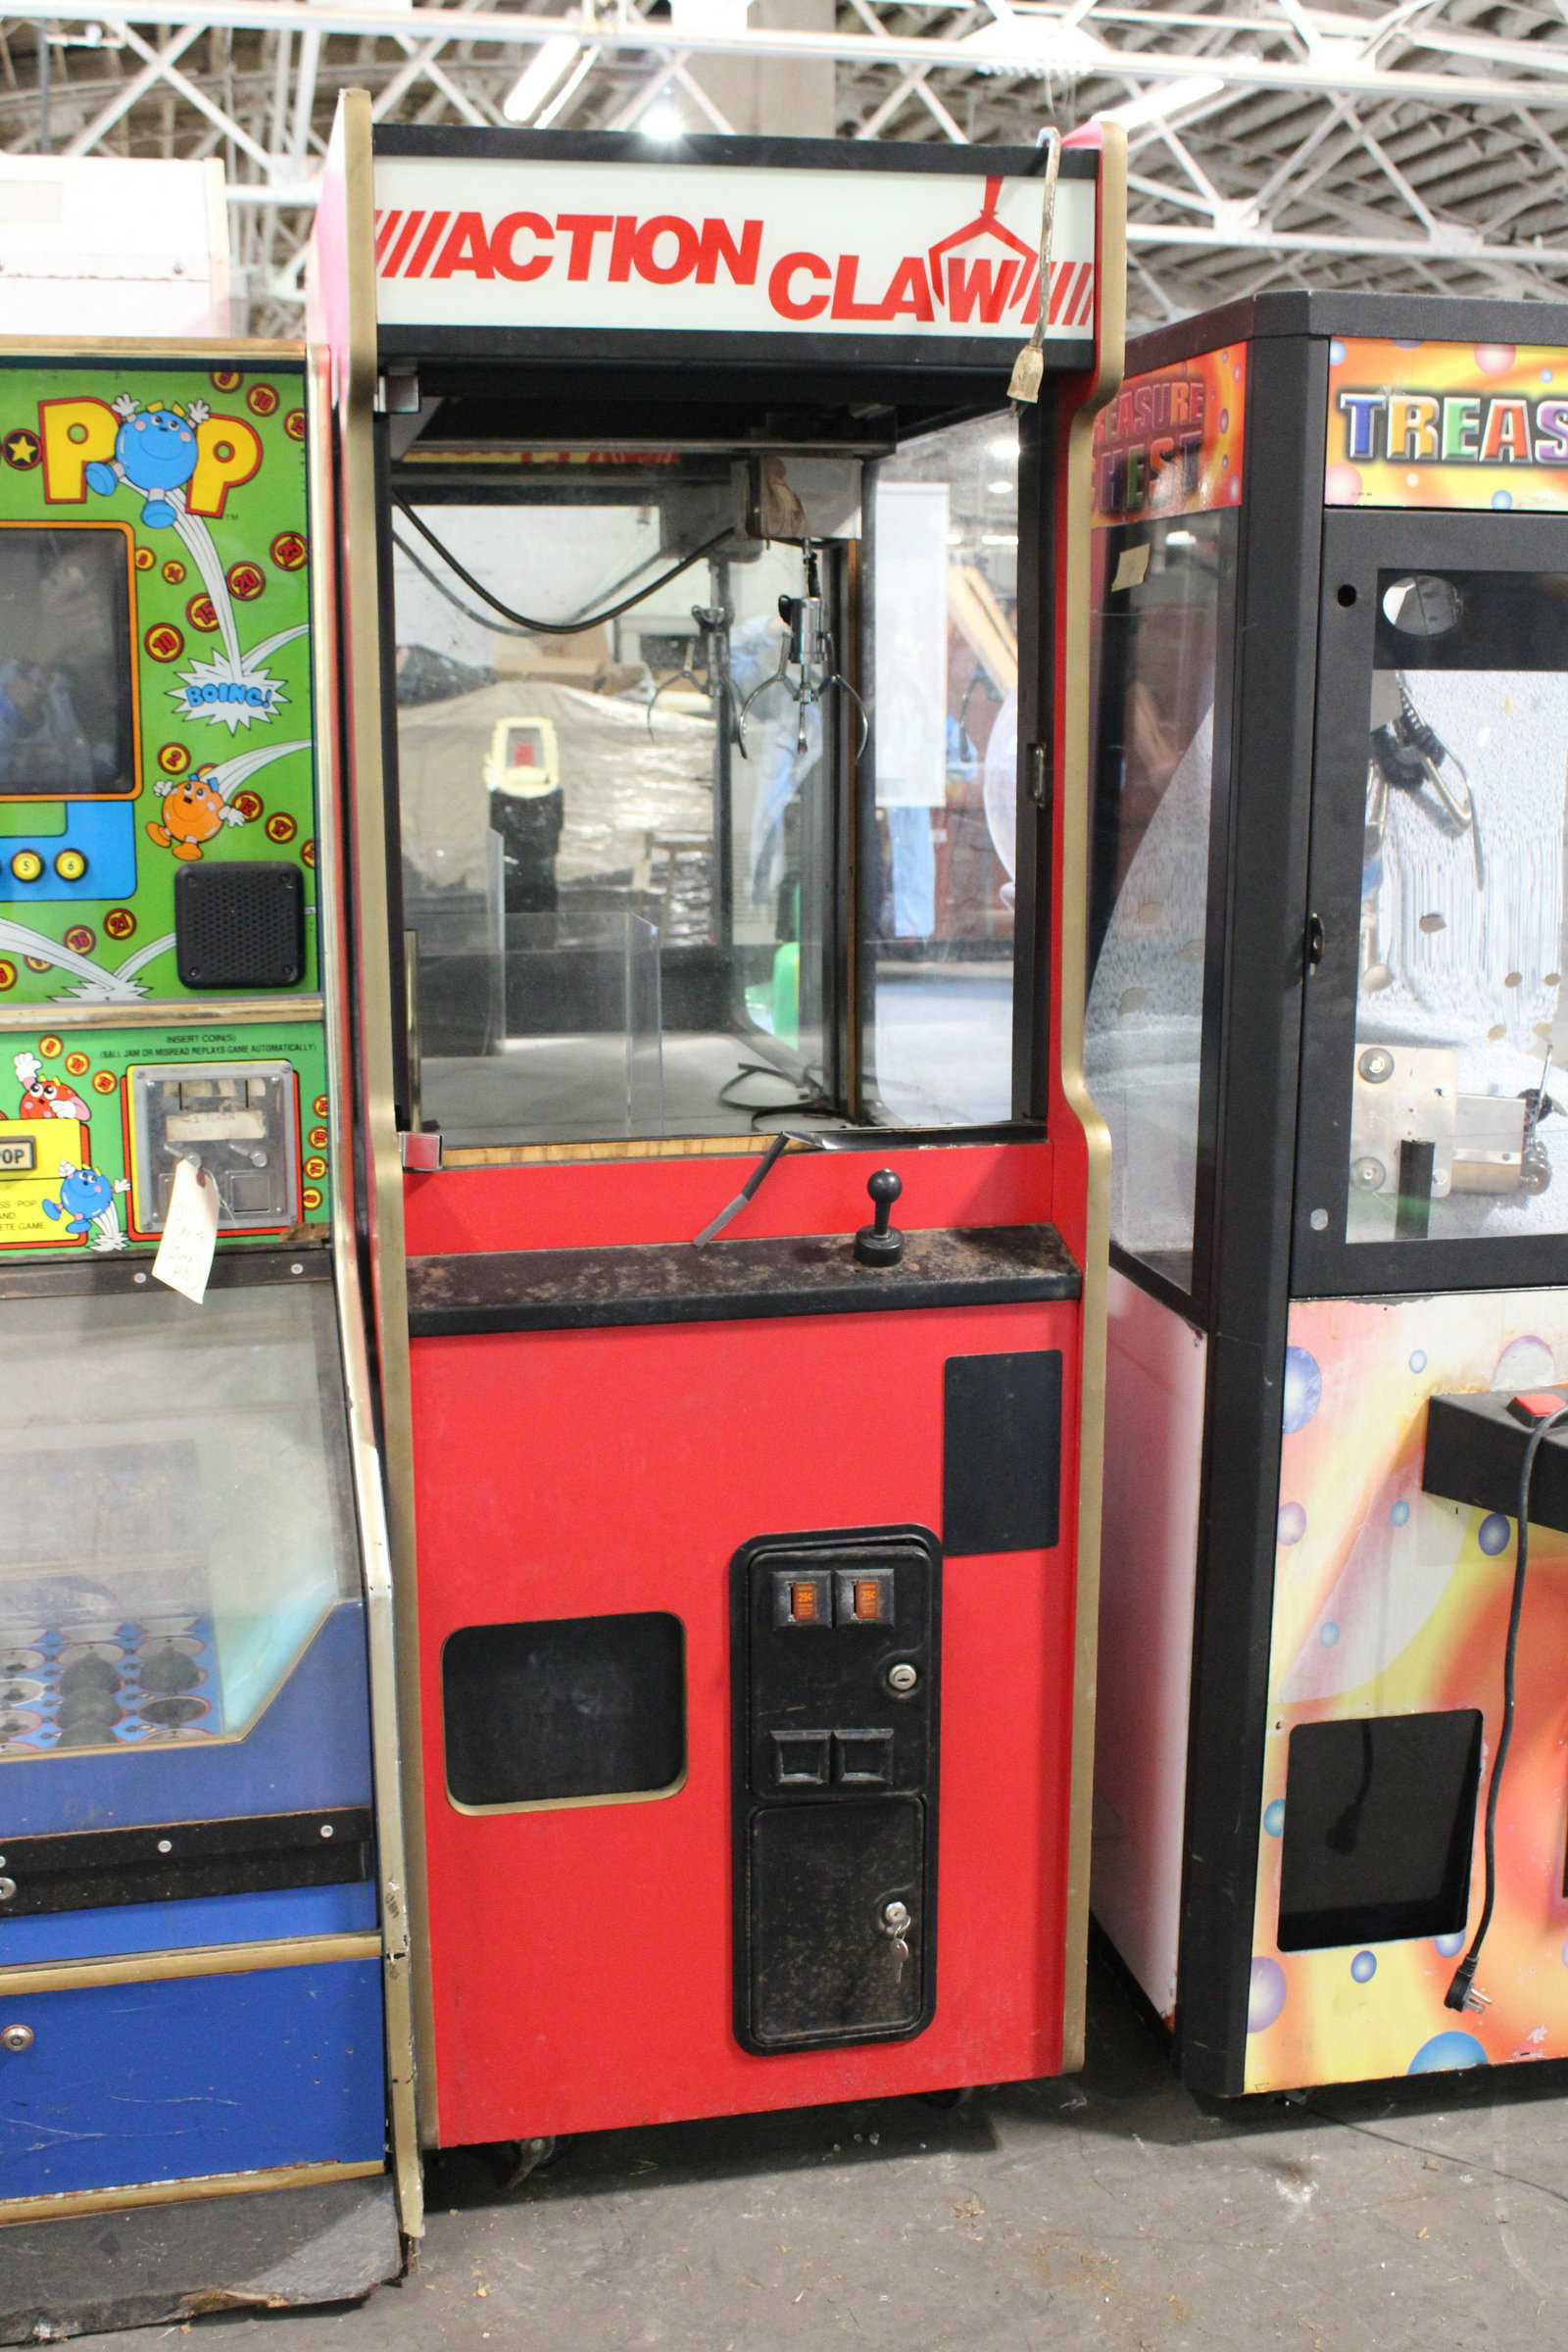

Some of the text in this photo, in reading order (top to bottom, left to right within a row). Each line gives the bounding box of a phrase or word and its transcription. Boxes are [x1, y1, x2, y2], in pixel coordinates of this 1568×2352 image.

[429, 211, 1020, 323] ACTION CLAW
[1093, 381, 1204, 445] REASURE
[1092, 430, 1202, 512] HEST
[277, 536, 303, 565] 25
[233, 568, 260, 595] 20
[152, 631, 177, 655] 10
[185, 683, 271, 709] BOING!
[167, 750, 182, 767] 2
[23, 861, 74, 871] 5 6
[100, 1043, 317, 1059] (BALL JAM OR MISREAD REPLAYS GAME AUTOMATICALLY)
[166, 1034, 236, 1044] INSERT COIN(S)
[0, 1149, 24, 1164] OP
[19, 1222, 46, 1231] GAME
